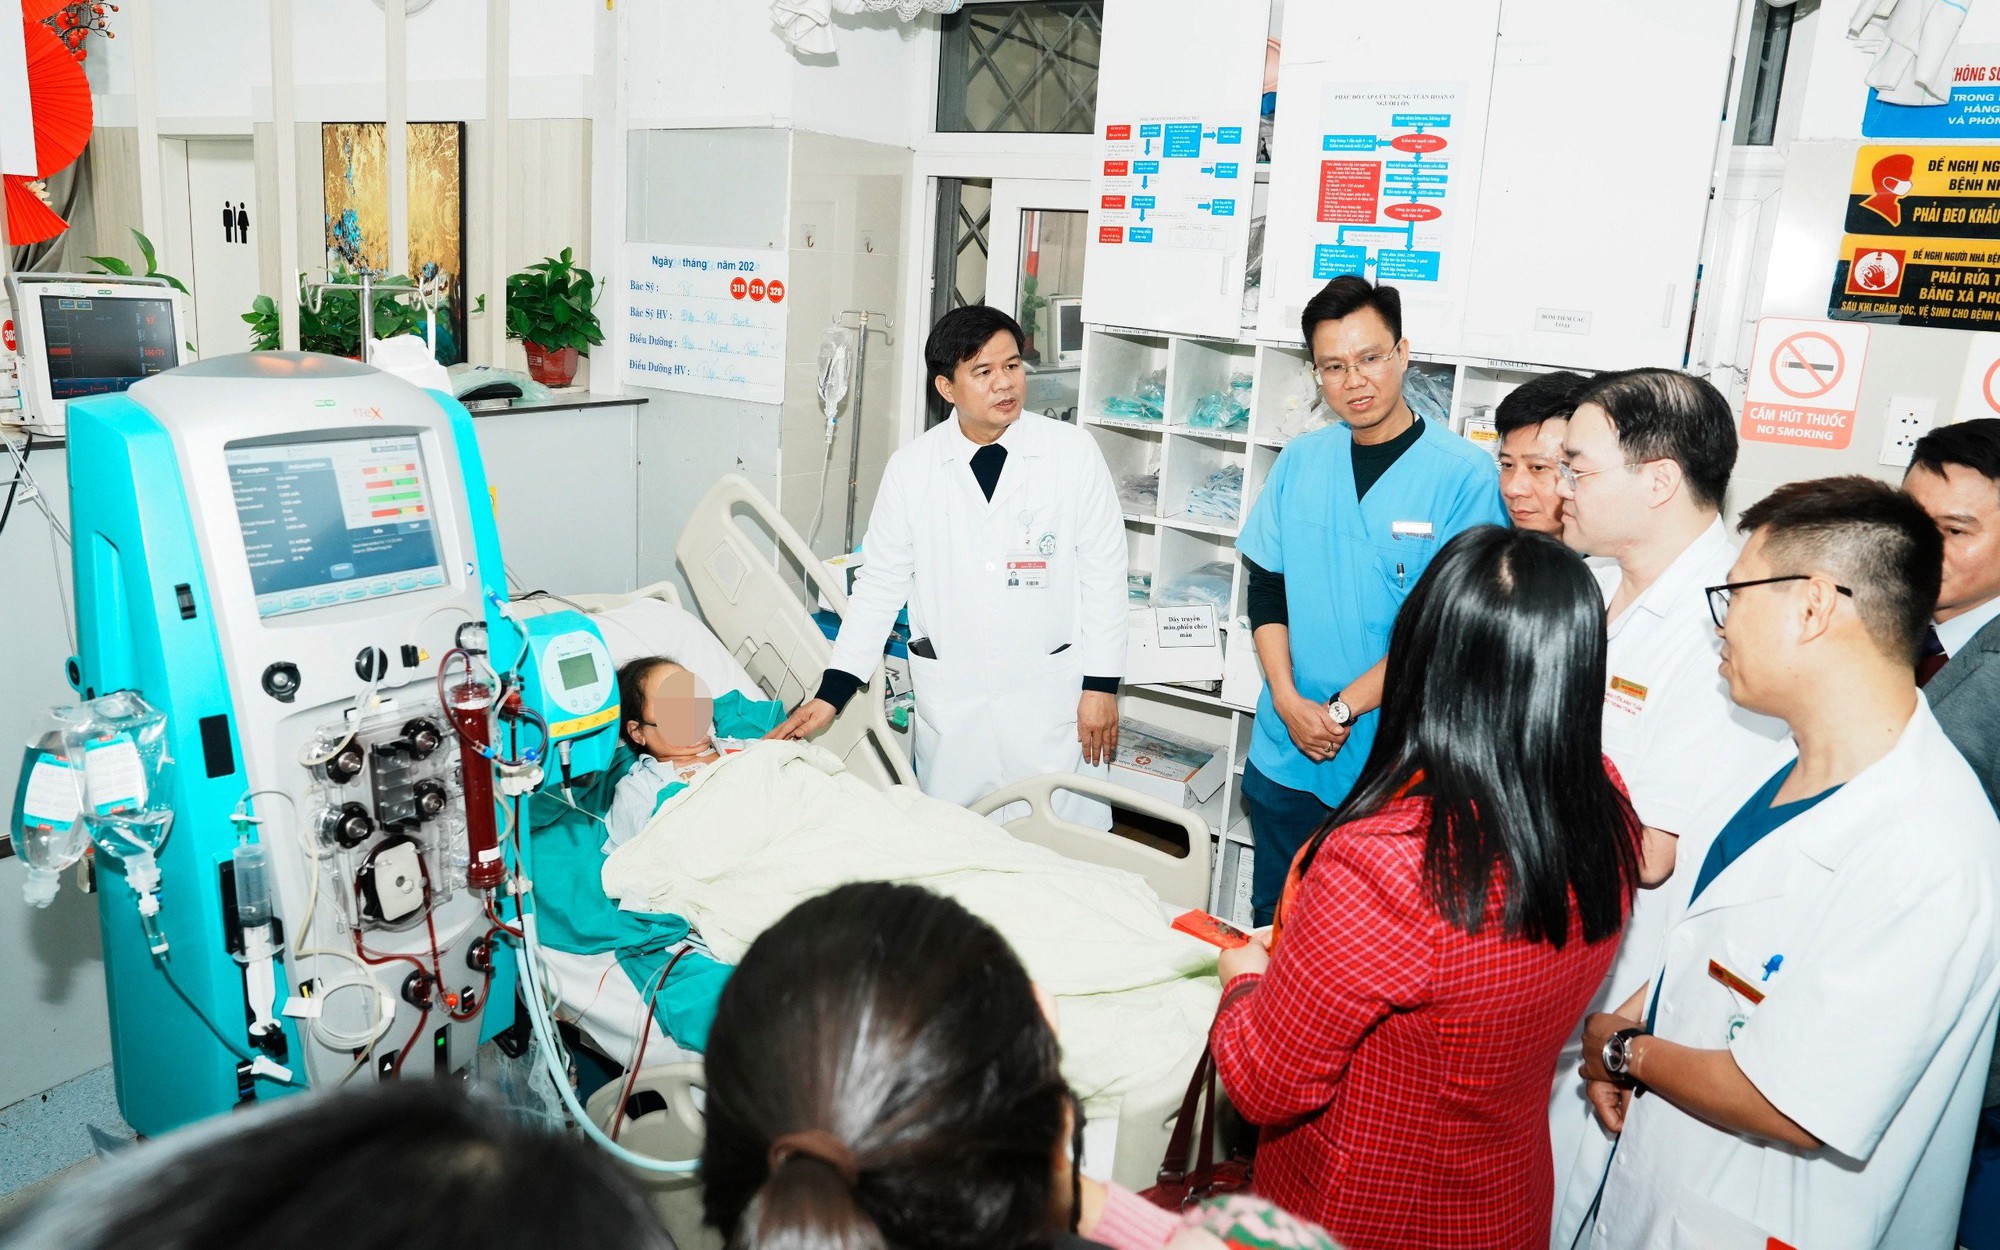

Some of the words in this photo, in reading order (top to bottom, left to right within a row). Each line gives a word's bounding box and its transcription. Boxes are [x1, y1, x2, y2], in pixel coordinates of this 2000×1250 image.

[1952, 64, 1986, 81] HÔNG
[1953, 94, 1994, 102] TRONG
[1948, 115, 1965, 124] VÀ
[1928, 155, 1946, 172] ĐỀ
[1948, 160, 1979, 174] NGHỊ
[1948, 176, 1984, 193] BỆNH
[1912, 201, 1941, 222] PHẢI
[1942, 208, 1967, 223] ĐEO
[1968, 202, 2000, 224] KHẨU
[652, 255, 674, 269] Ngày
[682, 258, 708, 271] tháng
[718, 260, 736, 270] năm
[1924, 251, 1942, 263] NGHỊ
[1944, 250, 1968, 262] NGƯỜI
[1970, 251, 1985, 262] NHÀ
[1930, 267, 1962, 284] PHẢI
[1964, 268, 1990, 286] RỬA
[630, 280, 644, 290] Bác
[732, 284, 745, 292] 318
[751, 285, 764, 295] 319
[1919, 283, 1954, 301] BẰNG
[1956, 287, 1974, 302] XÀ
[630, 306, 644, 317] Bác
[656, 310, 668, 320] HV
[1858, 302, 1872, 312] KHI
[1874, 302, 1897, 314] CHĂM
[1918, 304, 1929, 319] VỆ
[1930, 306, 1951, 318] SINH
[1952, 308, 1969, 318] CHO
[1970, 308, 1994, 322] BỆNH
[674, 365, 686, 375] HV
[1750, 406, 1776, 422] CẤM
[1778, 408, 1803, 424] HÚT
[1806, 411, 1847, 428] THUỐC
[1757, 424, 1775, 435] NO
[1776, 427, 1834, 440] SMOKING
